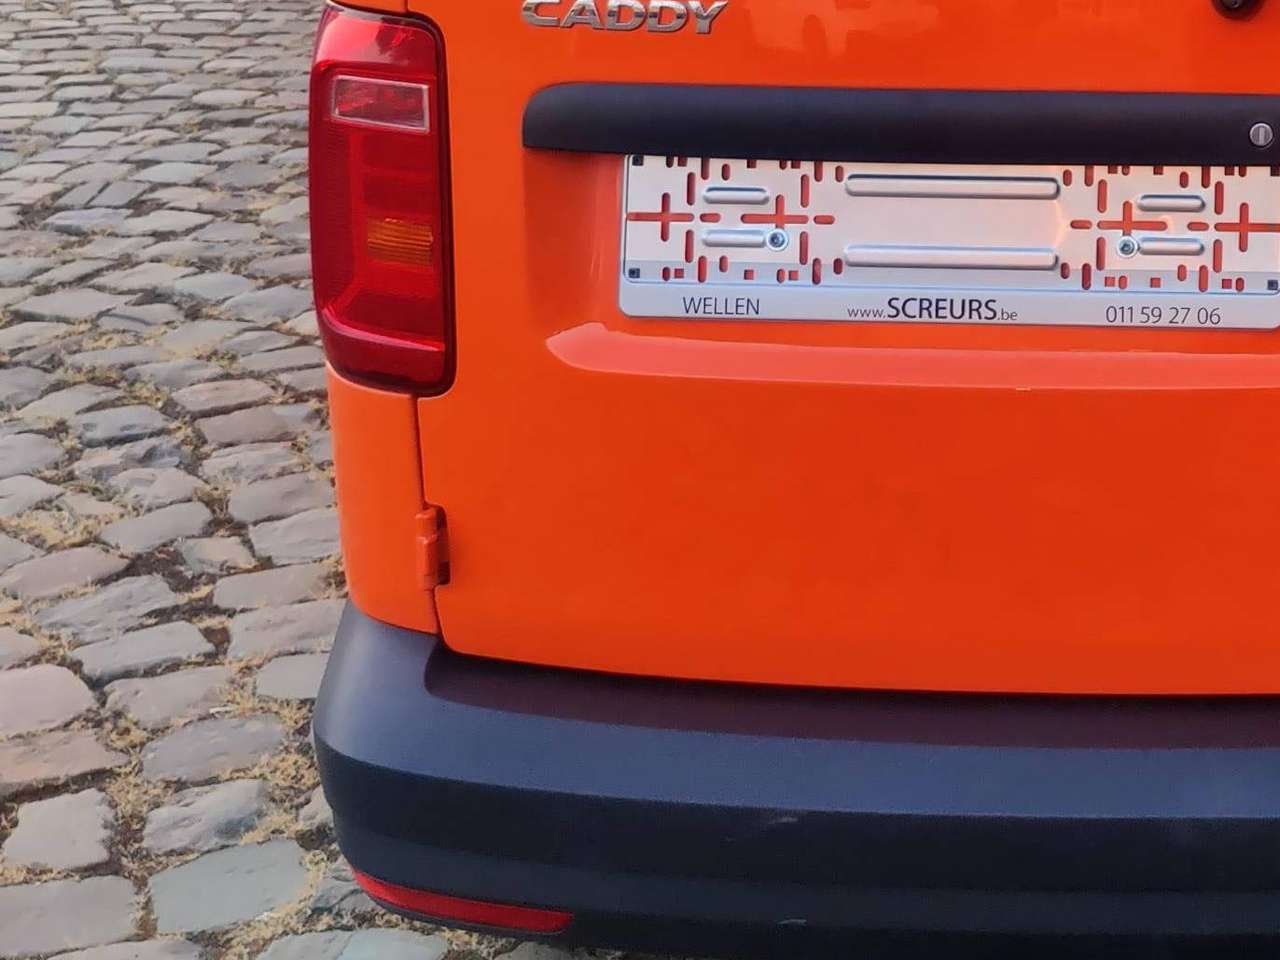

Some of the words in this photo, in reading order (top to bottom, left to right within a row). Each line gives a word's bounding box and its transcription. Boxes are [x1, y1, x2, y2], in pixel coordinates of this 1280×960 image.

[682, 296, 760, 315] WELLEN
[847, 297, 1018, 321] www.SCREURS.be
[1105, 305, 1134, 323] 011
[1139, 306, 1162, 324] 59
[1168, 306, 1191, 325] 27
[1197, 306, 1221, 325] 06
